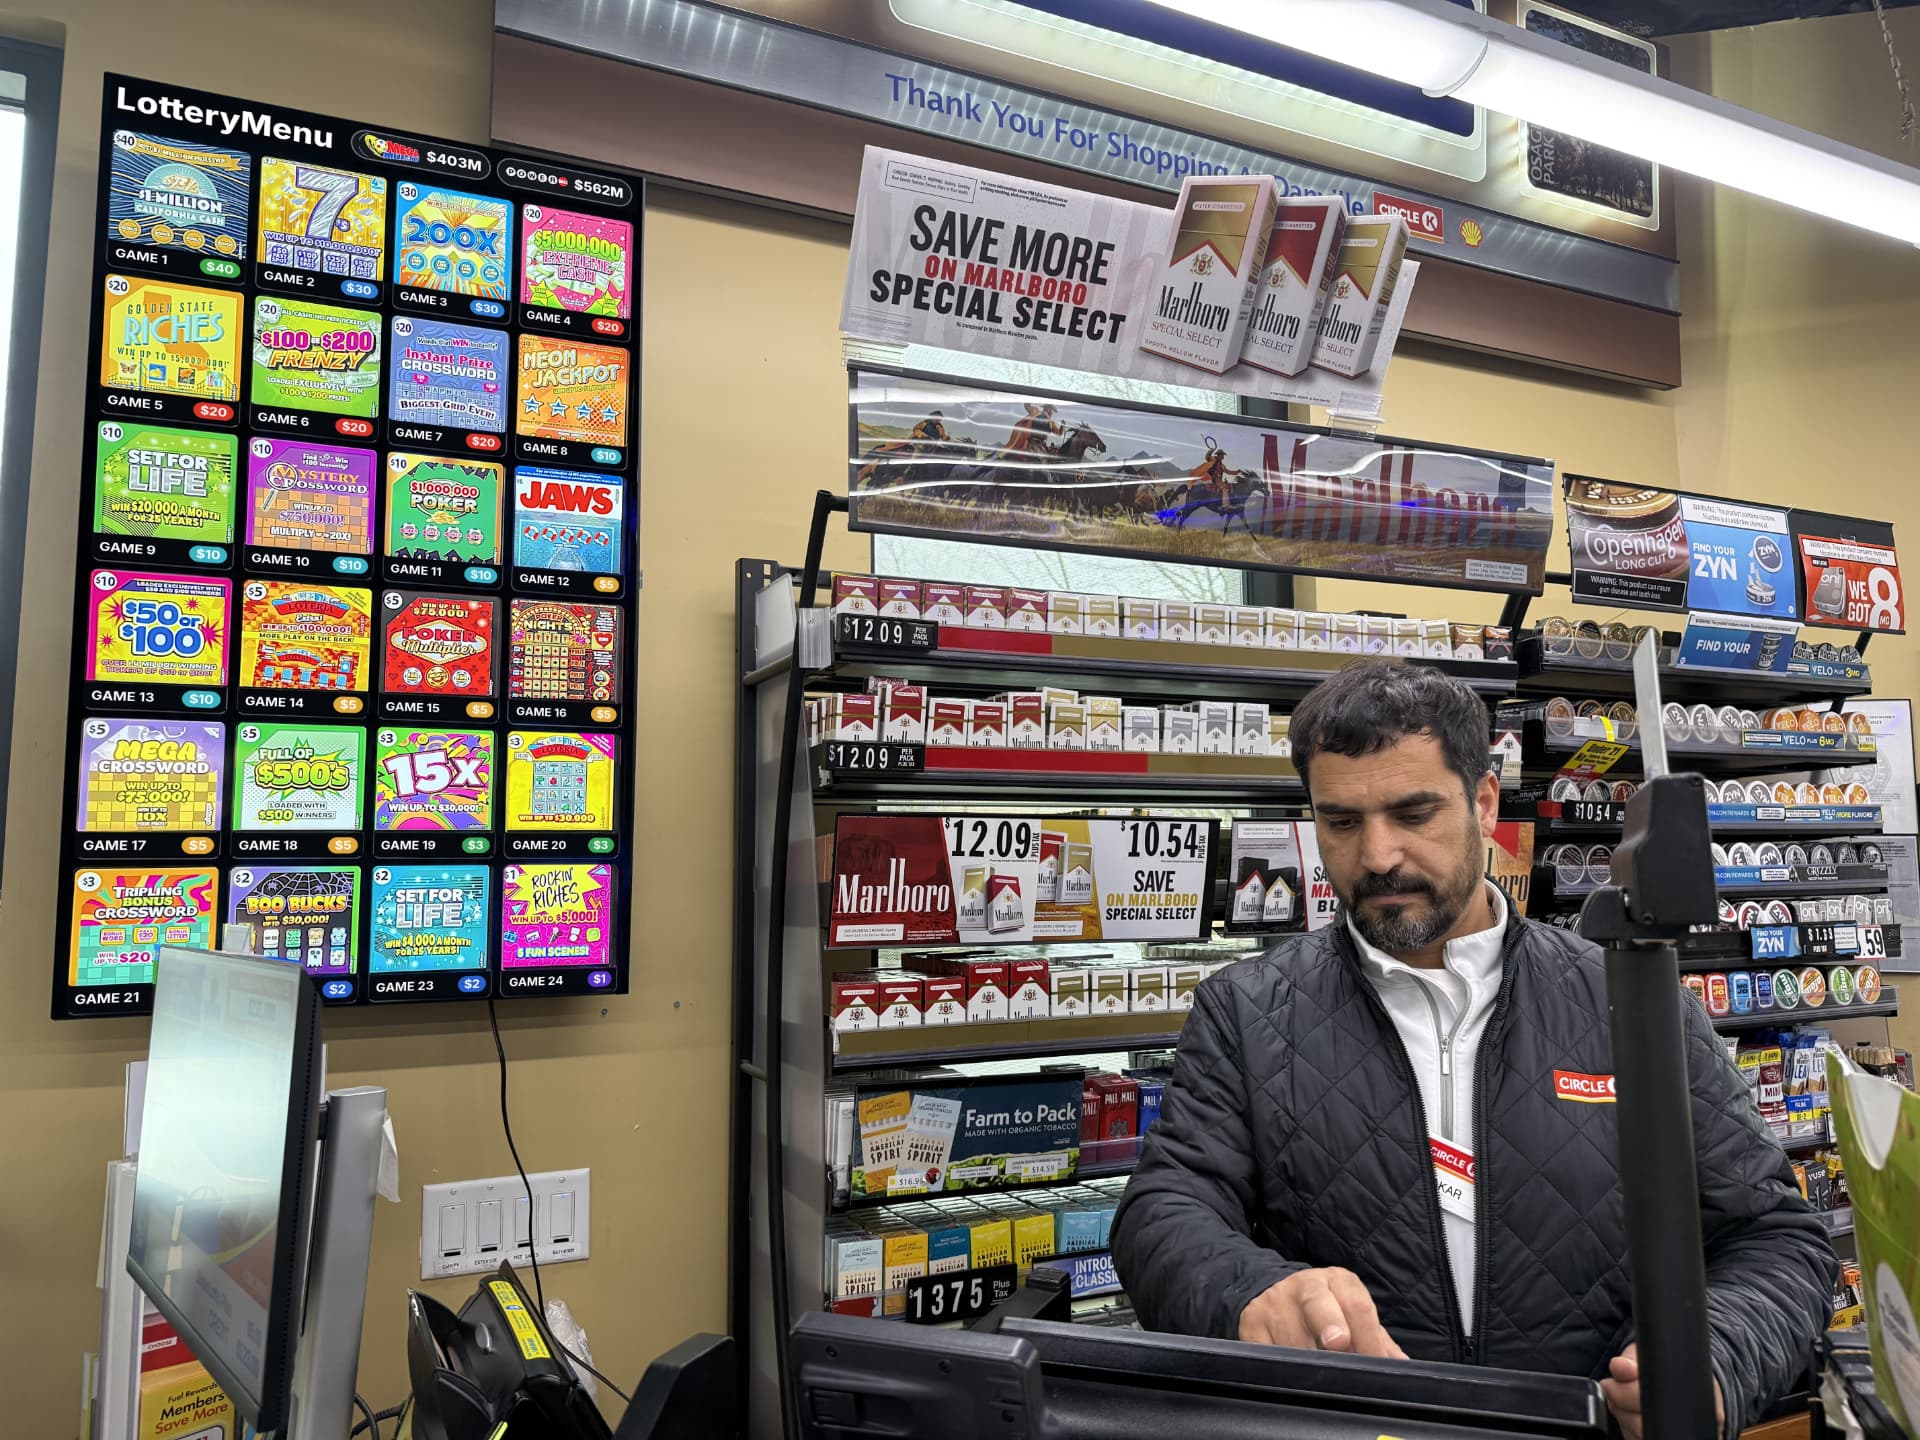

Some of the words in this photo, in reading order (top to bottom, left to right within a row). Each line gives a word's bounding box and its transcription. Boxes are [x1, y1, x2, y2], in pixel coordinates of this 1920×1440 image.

[117, 86, 333, 149] LotteryMenu
[885, 73, 982, 124] Thank
[991, 101, 1044, 138] You
[1054, 118, 1099, 151] For
[426, 151, 482, 172] $403M
[1544, 136, 1554, 184] PARK
[574, 179, 624, 199] $562M
[534, 230, 620, 260] $5,000,000
[910, 205, 1005, 264] SAVE
[1009, 224, 1115, 286] MORE
[115, 249, 158, 263] GAME
[161, 255, 168, 265] 1
[543, 251, 611, 274] EXTREME
[206, 262, 233, 274] $40
[558, 266, 596, 283] CASH
[924, 255, 958, 281] ON
[963, 262, 1088, 305] MARLBORO
[128, 303, 173, 314] GOLDEN
[179, 301, 214, 312] STATE
[474, 303, 499, 314] $30
[870, 269, 1003, 324] SPECIAL
[1013, 296, 1126, 344] SELECT
[1155, 282, 1230, 333] Marlboro
[526, 311, 559, 324] GAME
[562, 316, 571, 325] 4
[124, 311, 225, 345] RICHES
[1151, 321, 1185, 340] SPECIAL
[1187, 331, 1223, 349] SELECT
[1261, 337, 1293, 355] SELECT
[269, 350, 366, 370] FRENZY
[405, 348, 454, 364] Instant
[459, 354, 493, 369] Prize
[401, 360, 497, 380] CROSSWORD
[533, 364, 620, 388] JACKPOT
[200, 406, 227, 417] $20
[258, 412, 295, 424] GAME
[300, 417, 309, 427] 6
[127, 450, 166, 465] SET
[168, 452, 208, 470] FOR
[128, 465, 207, 497] LIFE
[273, 465, 359, 483] MYSTERY
[271, 476, 367, 494] CROSSWORD
[411, 495, 477, 513] POKER
[520, 480, 614, 515] JAWS
[100, 542, 144, 554] GAME
[147, 546, 156, 555] 9
[1584, 518, 1686, 566] Copenhagen
[1693, 543, 1710, 553] FIND
[1712, 544, 1735, 557] YOUR
[1615, 557, 1646, 570] LONG
[1648, 553, 1667, 568] CUT
[1693, 555, 1738, 581] ZYN
[520, 574, 555, 585] GAME
[559, 577, 569, 586] 12
[1848, 580, 1867, 600] WE
[1868, 567, 1900, 630] 8
[123, 600, 179, 627] $50
[179, 616, 202, 628] or
[1848, 602, 1870, 623] GOT
[401, 627, 478, 642] POKER
[523, 620, 573, 631] NIGHTS
[122, 623, 203, 656] $100
[402, 640, 475, 657] Multiplier
[1696, 639, 1721, 653] FIND
[1723, 642, 1750, 654] YOUR
[1811, 665, 1833, 676] VELO
[386, 702, 423, 713] GAME
[427, 704, 439, 713] 15
[597, 710, 611, 719] $5
[1784, 735, 1806, 745] VELO
[114, 740, 198, 761] MEGA
[259, 748, 291, 760] FULL
[295, 748, 313, 759] OF
[828, 745, 888, 769] $12.09
[99, 761, 209, 774] CROSSWORD
[1576, 803, 1610, 821] $10.54
[83, 840, 128, 851] GAME
[132, 840, 146, 850] 17
[513, 840, 548, 850] GAME
[551, 840, 566, 850] 20
[945, 817, 1031, 859] $12.09
[1120, 820, 1198, 859] $10.54
[1807, 866, 1838, 875] GRIZZLY
[836, 858, 950, 914] Marlboro
[1133, 870, 1176, 892] SAVE
[113, 886, 182, 898] TRIPLING
[396, 889, 429, 903] SET
[431, 889, 463, 901] FOR
[533, 882, 579, 911] RICHES
[1106, 893, 1125, 906] ON
[1127, 893, 1199, 906] MARLBORO
[122, 896, 172, 907] BONUS
[247, 897, 283, 913] BOO
[287, 894, 348, 912] BUCKS
[94, 905, 198, 919] CROSSWORD
[396, 903, 463, 927] LIFE
[1105, 907, 1152, 921] SPECIAL
[1155, 907, 1196, 920] SELECT
[525, 947, 546, 957] FUN
[548, 946, 589, 957] SCENES!
[1757, 937, 1785, 953] ZYN
[509, 977, 545, 987] GAME
[548, 976, 563, 986] 24
[593, 974, 606, 983] $1
[75, 993, 120, 1004] GAME
[124, 992, 139, 1003] 21
[1559, 1077, 1606, 1093] CIRCLE
[1105, 1093, 1118, 1105] PALL
[1121, 1090, 1135, 1102] MALL
[964, 1108, 1010, 1128] Farm
[1014, 1106, 1034, 1124] to
[1037, 1102, 1077, 1122] Pack
[965, 1128, 986, 1138] MADE
[987, 1127, 1007, 1136] WITH
[1008, 1125, 1042, 1135] ORGANIC
[1044, 1122, 1077, 1132] TOBACCO
[907, 1149, 942, 1164] SPIRIT
[992, 1280, 1010, 1290] Plus
[993, 1289, 1009, 1298] Tax
[147, 1339, 173, 1350] CHOOSE
[168, 1392, 184, 1403] Fuel
[185, 1382, 218, 1399] Rewards
[160, 1392, 225, 1421] Members
[155, 1414, 190, 1435] Save
[193, 1403, 229, 1423] More
